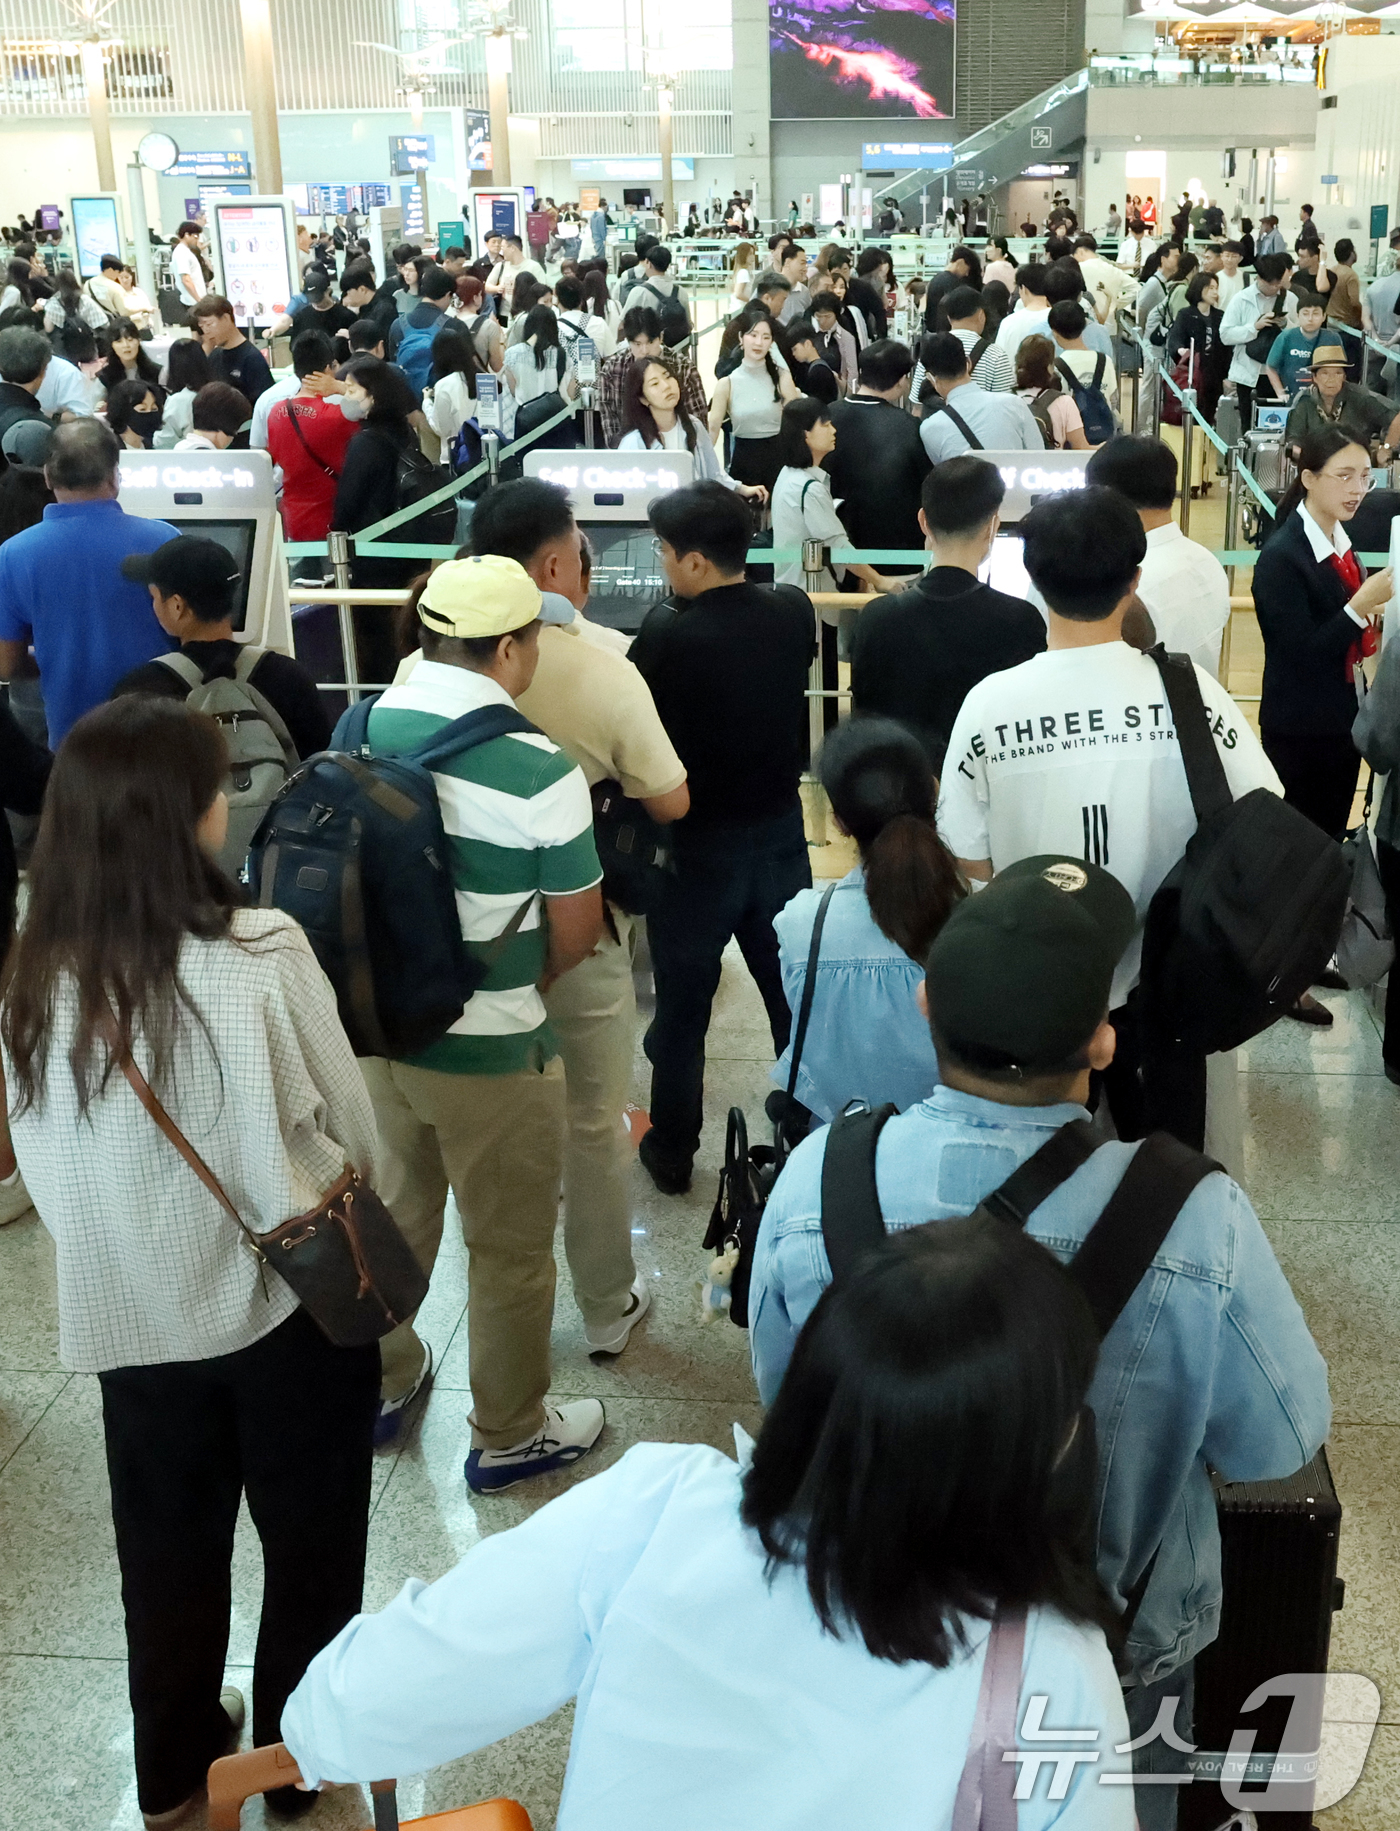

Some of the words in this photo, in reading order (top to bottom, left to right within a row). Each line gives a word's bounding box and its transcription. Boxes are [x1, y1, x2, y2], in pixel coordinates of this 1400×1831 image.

[121, 466, 158, 488] Self
[1020, 466, 1085, 490] Check
[995, 709, 1105, 747] THREE
[985, 752, 1006, 765] THE
[1011, 743, 1055, 759] BRAND
[1061, 736, 1097, 750] WITH
[1103, 733, 1128, 744] THE
[1136, 732, 1143, 742] 3
[1149, 730, 1174, 741] STR
[1188, 1761, 1224, 1772] VOYA
[1228, 1762, 1264, 1773] REAL
[1267, 1763, 1295, 1773] THE
